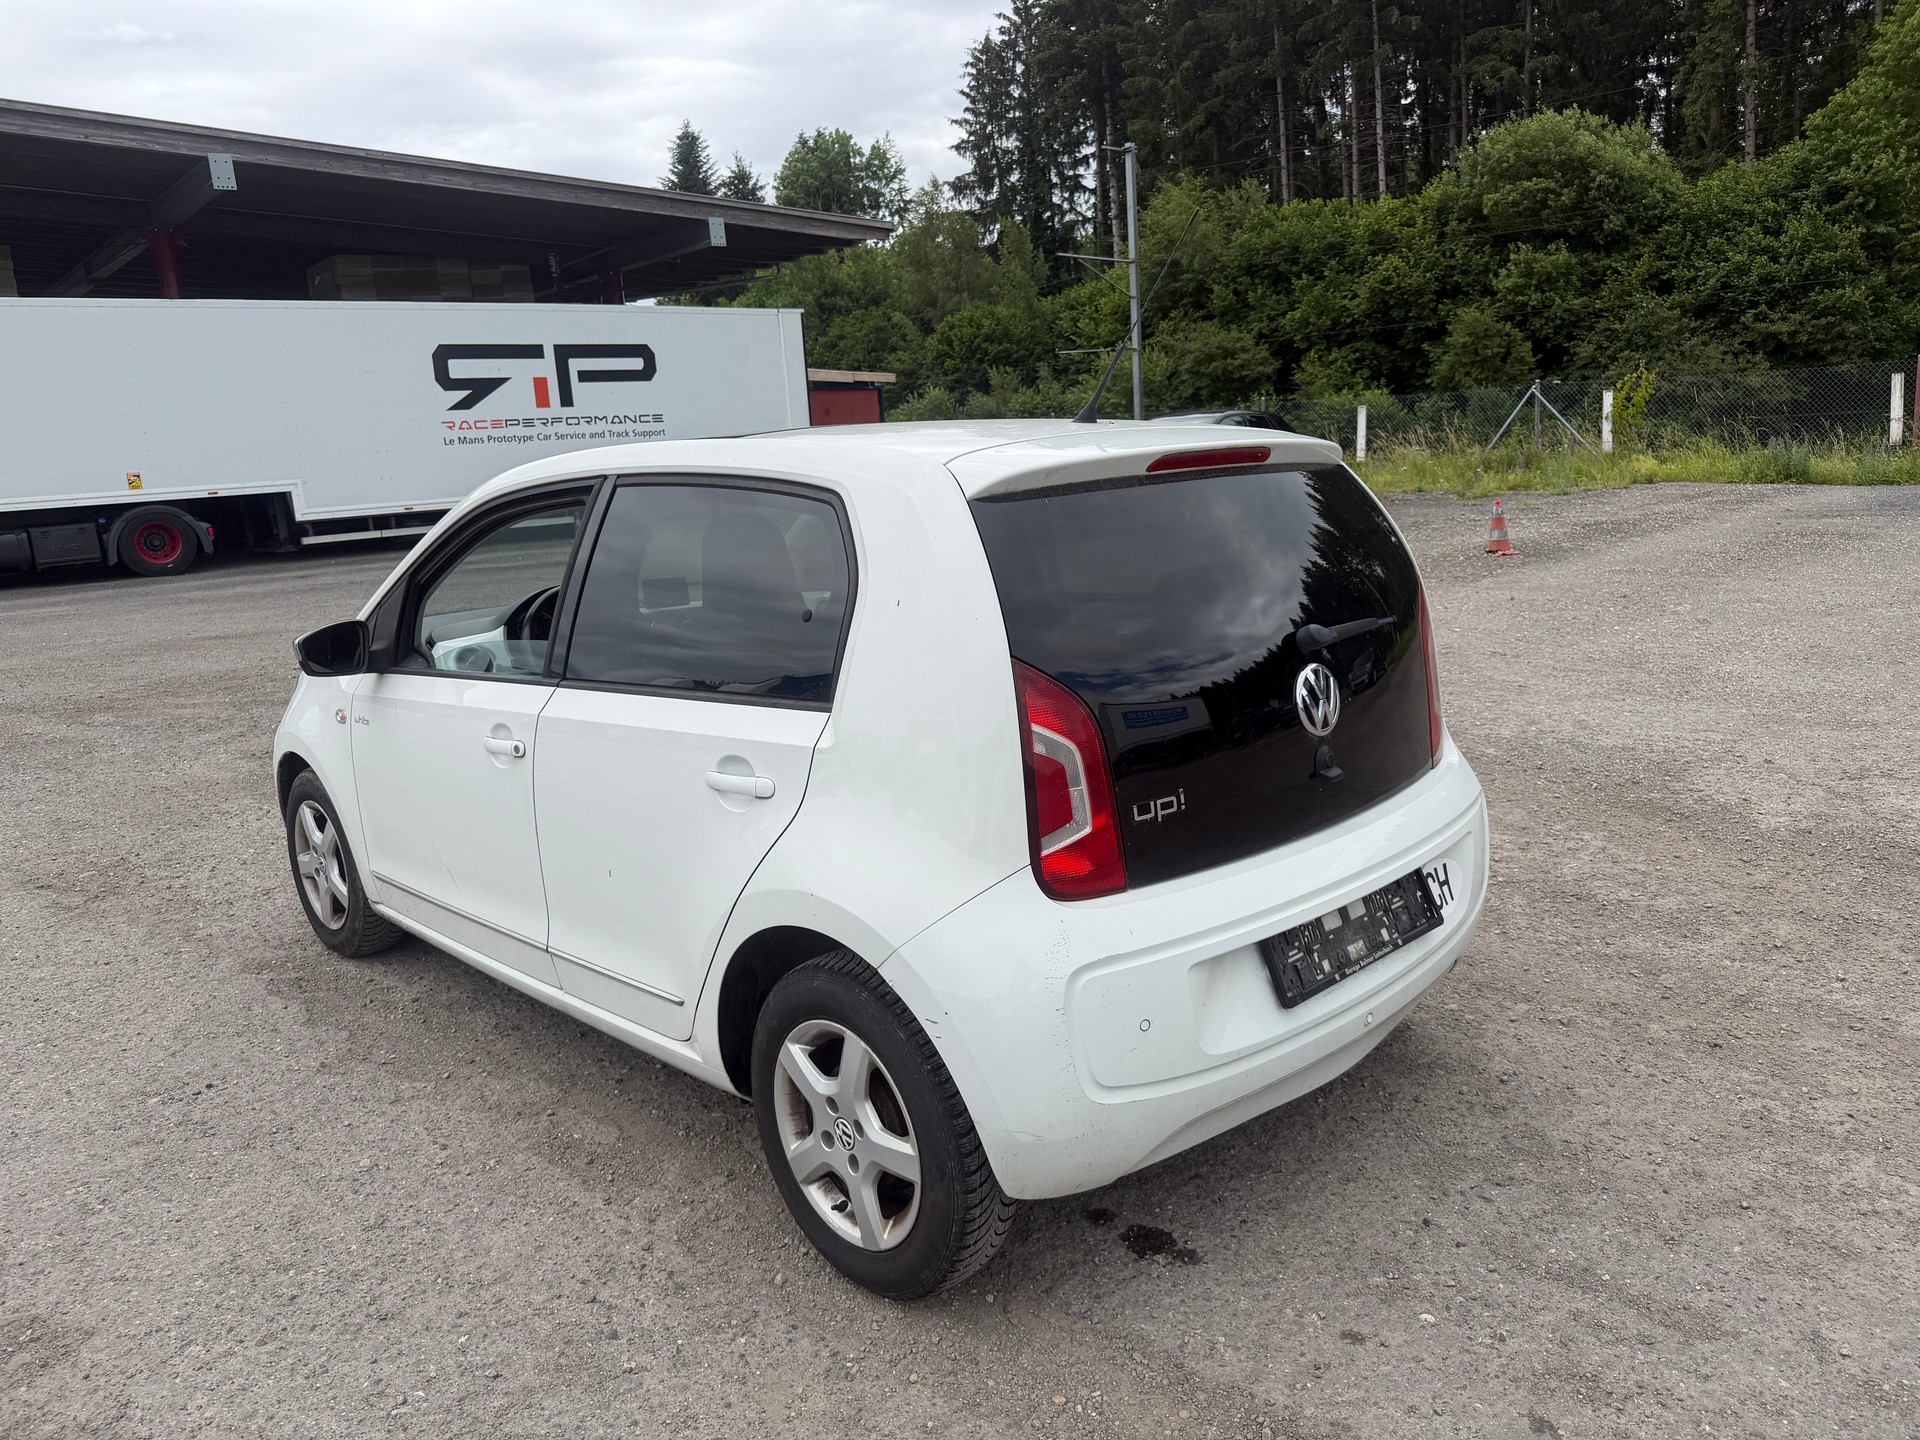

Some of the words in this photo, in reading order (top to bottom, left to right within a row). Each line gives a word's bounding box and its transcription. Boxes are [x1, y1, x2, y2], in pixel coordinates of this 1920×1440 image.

[441, 414, 665, 430] RACEPERFORMANCE
[443, 436, 455, 446] Le
[458, 436, 485, 445] Mans
[487, 434, 534, 444] Prototype
[537, 432, 552, 441] Car
[554, 431, 587, 440] Service
[589, 430, 606, 439] and
[607, 429, 630, 438] Track
[633, 428, 666, 438] Support
[1132, 788, 1186, 822] up!
[1425, 863, 1454, 911] CH
